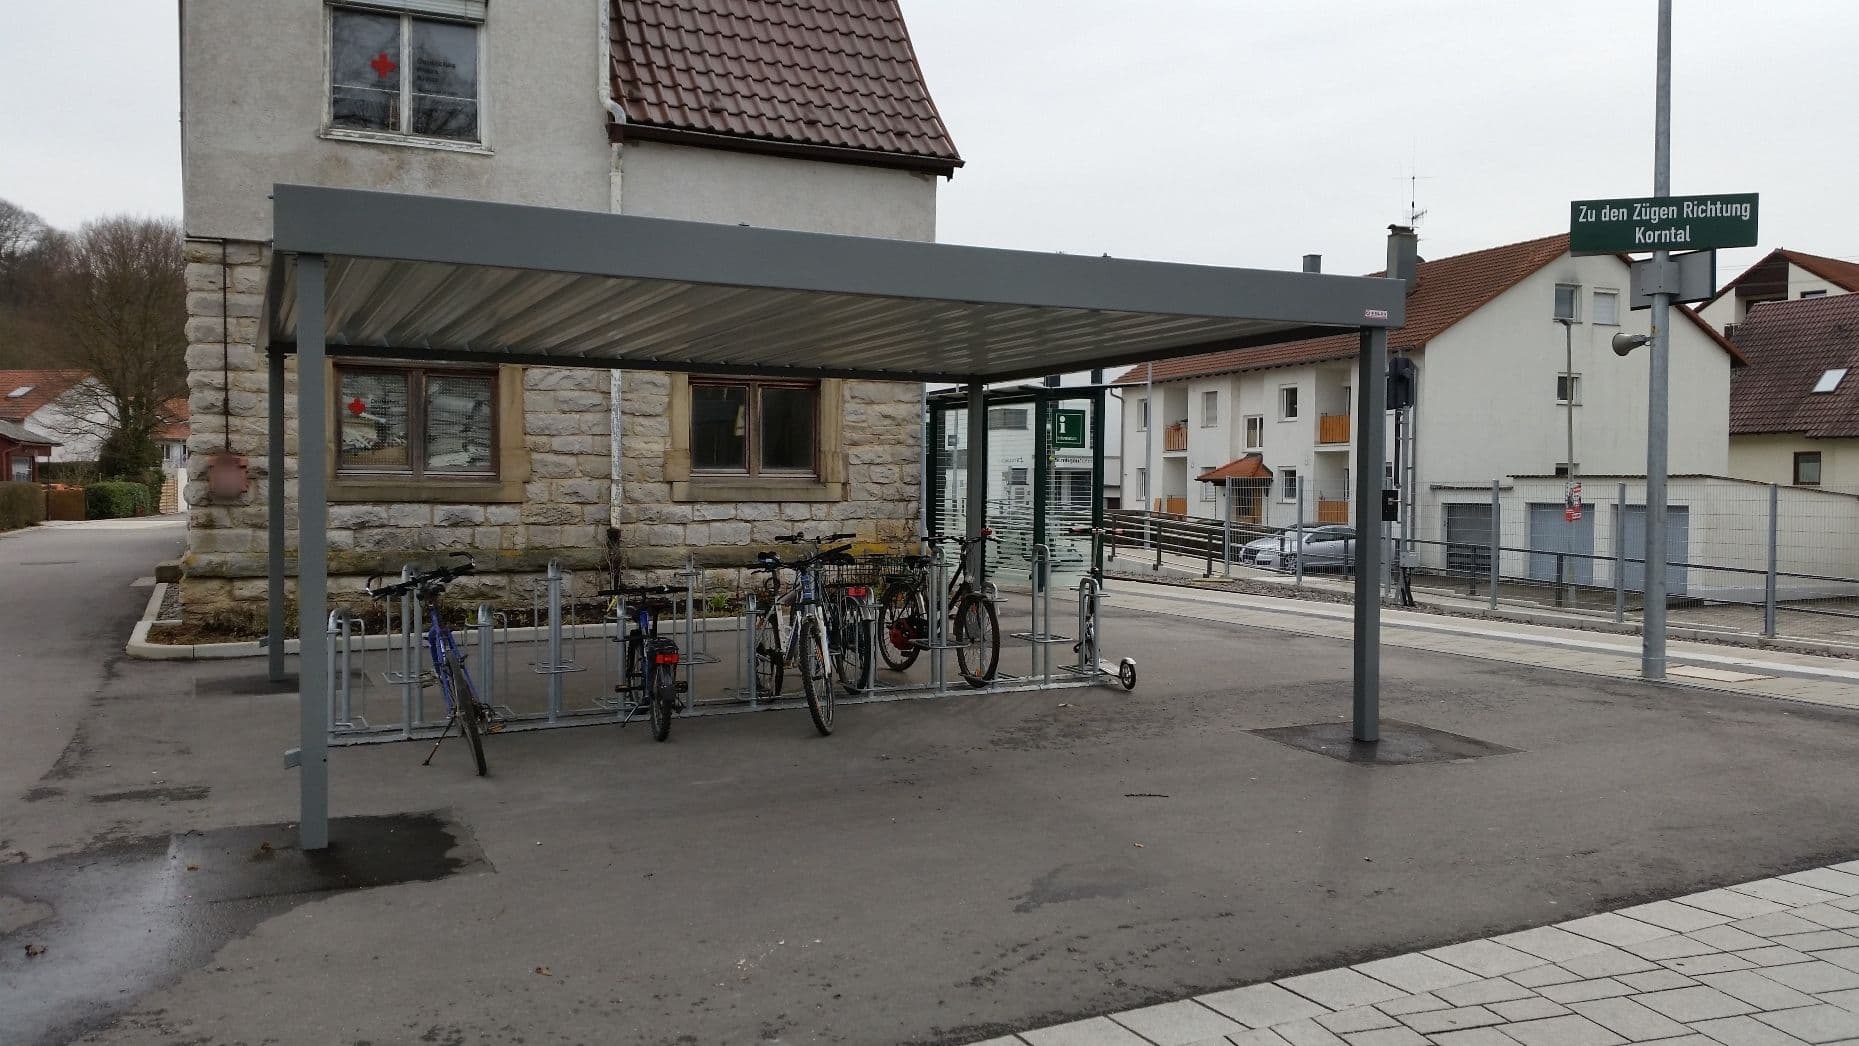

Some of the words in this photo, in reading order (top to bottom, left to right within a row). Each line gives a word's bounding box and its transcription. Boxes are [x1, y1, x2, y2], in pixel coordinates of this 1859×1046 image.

[1578, 205, 1596, 222] Zu
[1601, 205, 1628, 221] den
[1632, 202, 1677, 223] Zügen
[1683, 200, 1751, 221] Richtung
[1635, 225, 1691, 244] Korntal
